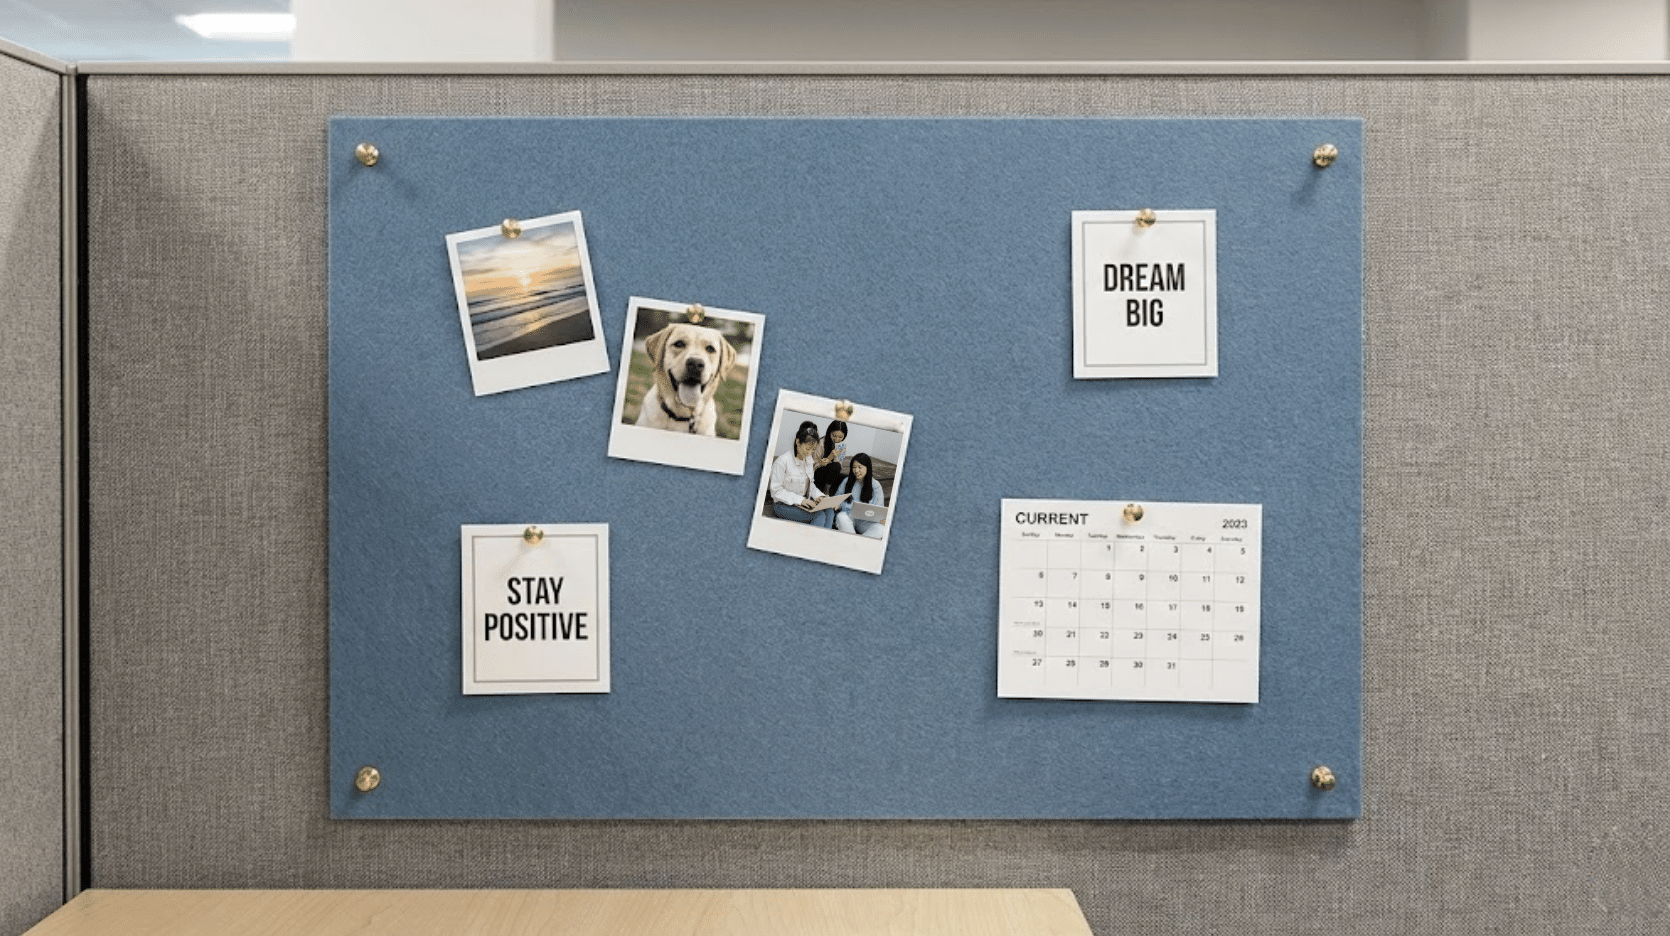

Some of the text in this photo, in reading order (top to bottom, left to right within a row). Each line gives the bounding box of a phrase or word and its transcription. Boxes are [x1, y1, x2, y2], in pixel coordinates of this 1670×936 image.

[1103, 262, 1186, 292] DREAM
[1126, 298, 1164, 328] BIG
[1015, 511, 1090, 525] CURRENT
[1221, 518, 1248, 529] 2023
[1139, 545, 1145, 553] 2
[1173, 545, 1179, 554] 3
[1206, 546, 1213, 554] 4
[1240, 547, 1246, 555] 5
[1072, 571, 1078, 580] 7
[1138, 573, 1145, 582] 9
[1168, 573, 1179, 583] 10
[1202, 575, 1211, 583] 11
[1235, 575, 1246, 584] 12
[506, 576, 564, 606] STAY
[1033, 599, 1044, 608] 13
[1067, 601, 1078, 609] 14
[1134, 602, 1145, 611] 16
[484, 611, 589, 641] POSITIVE
[1065, 629, 1076, 639] 21
[1133, 631, 1144, 640] 23
[1166, 632, 1178, 641] 24
[1200, 633, 1211, 642] 25
